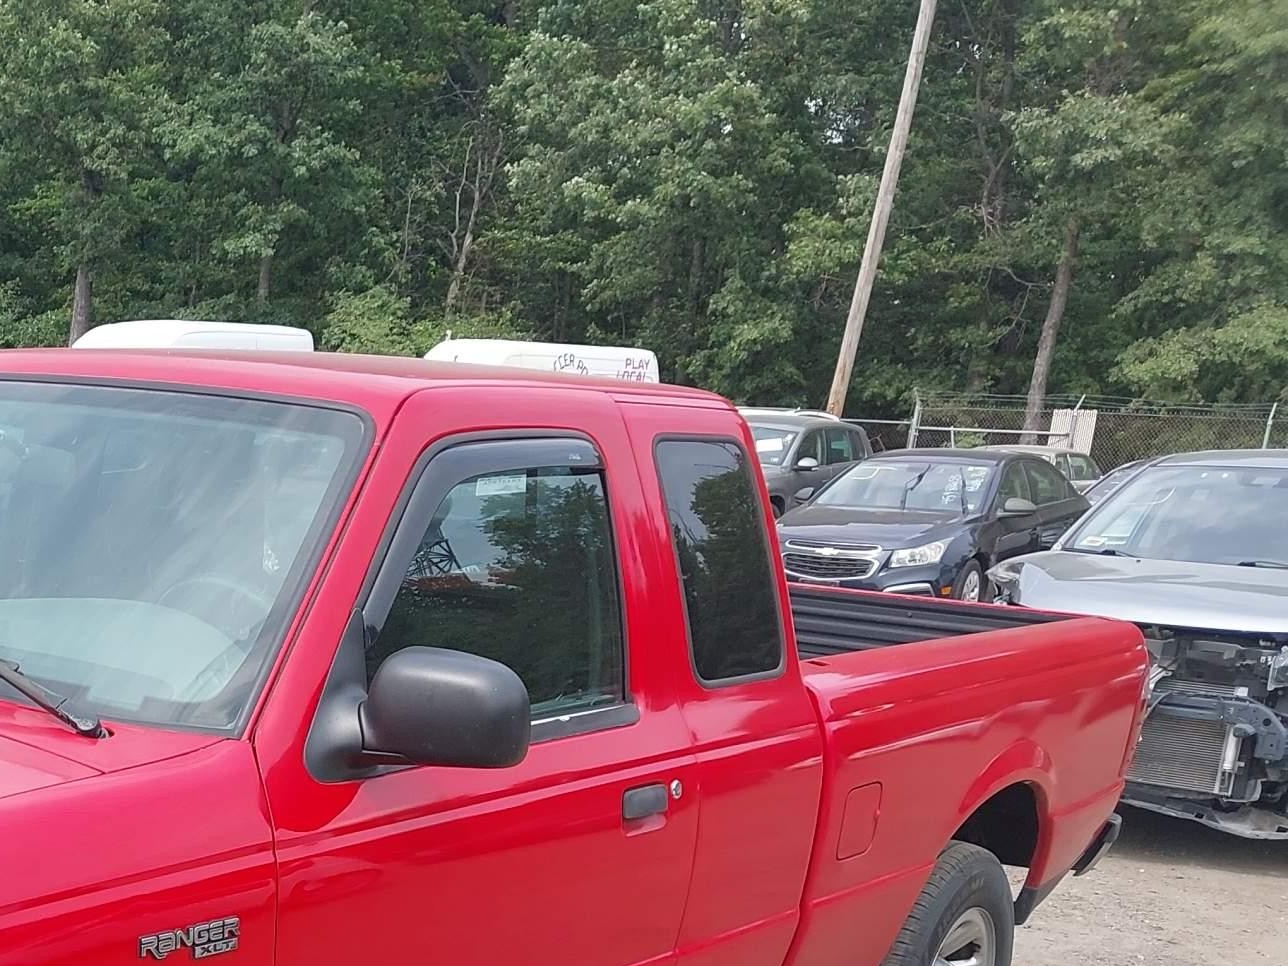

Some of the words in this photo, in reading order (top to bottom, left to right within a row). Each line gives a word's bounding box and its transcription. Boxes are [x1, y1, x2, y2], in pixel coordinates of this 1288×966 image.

[625, 358, 650, 370] PLAY
[139, 915, 240, 959] RANGER
[199, 939, 236, 956] XLT
